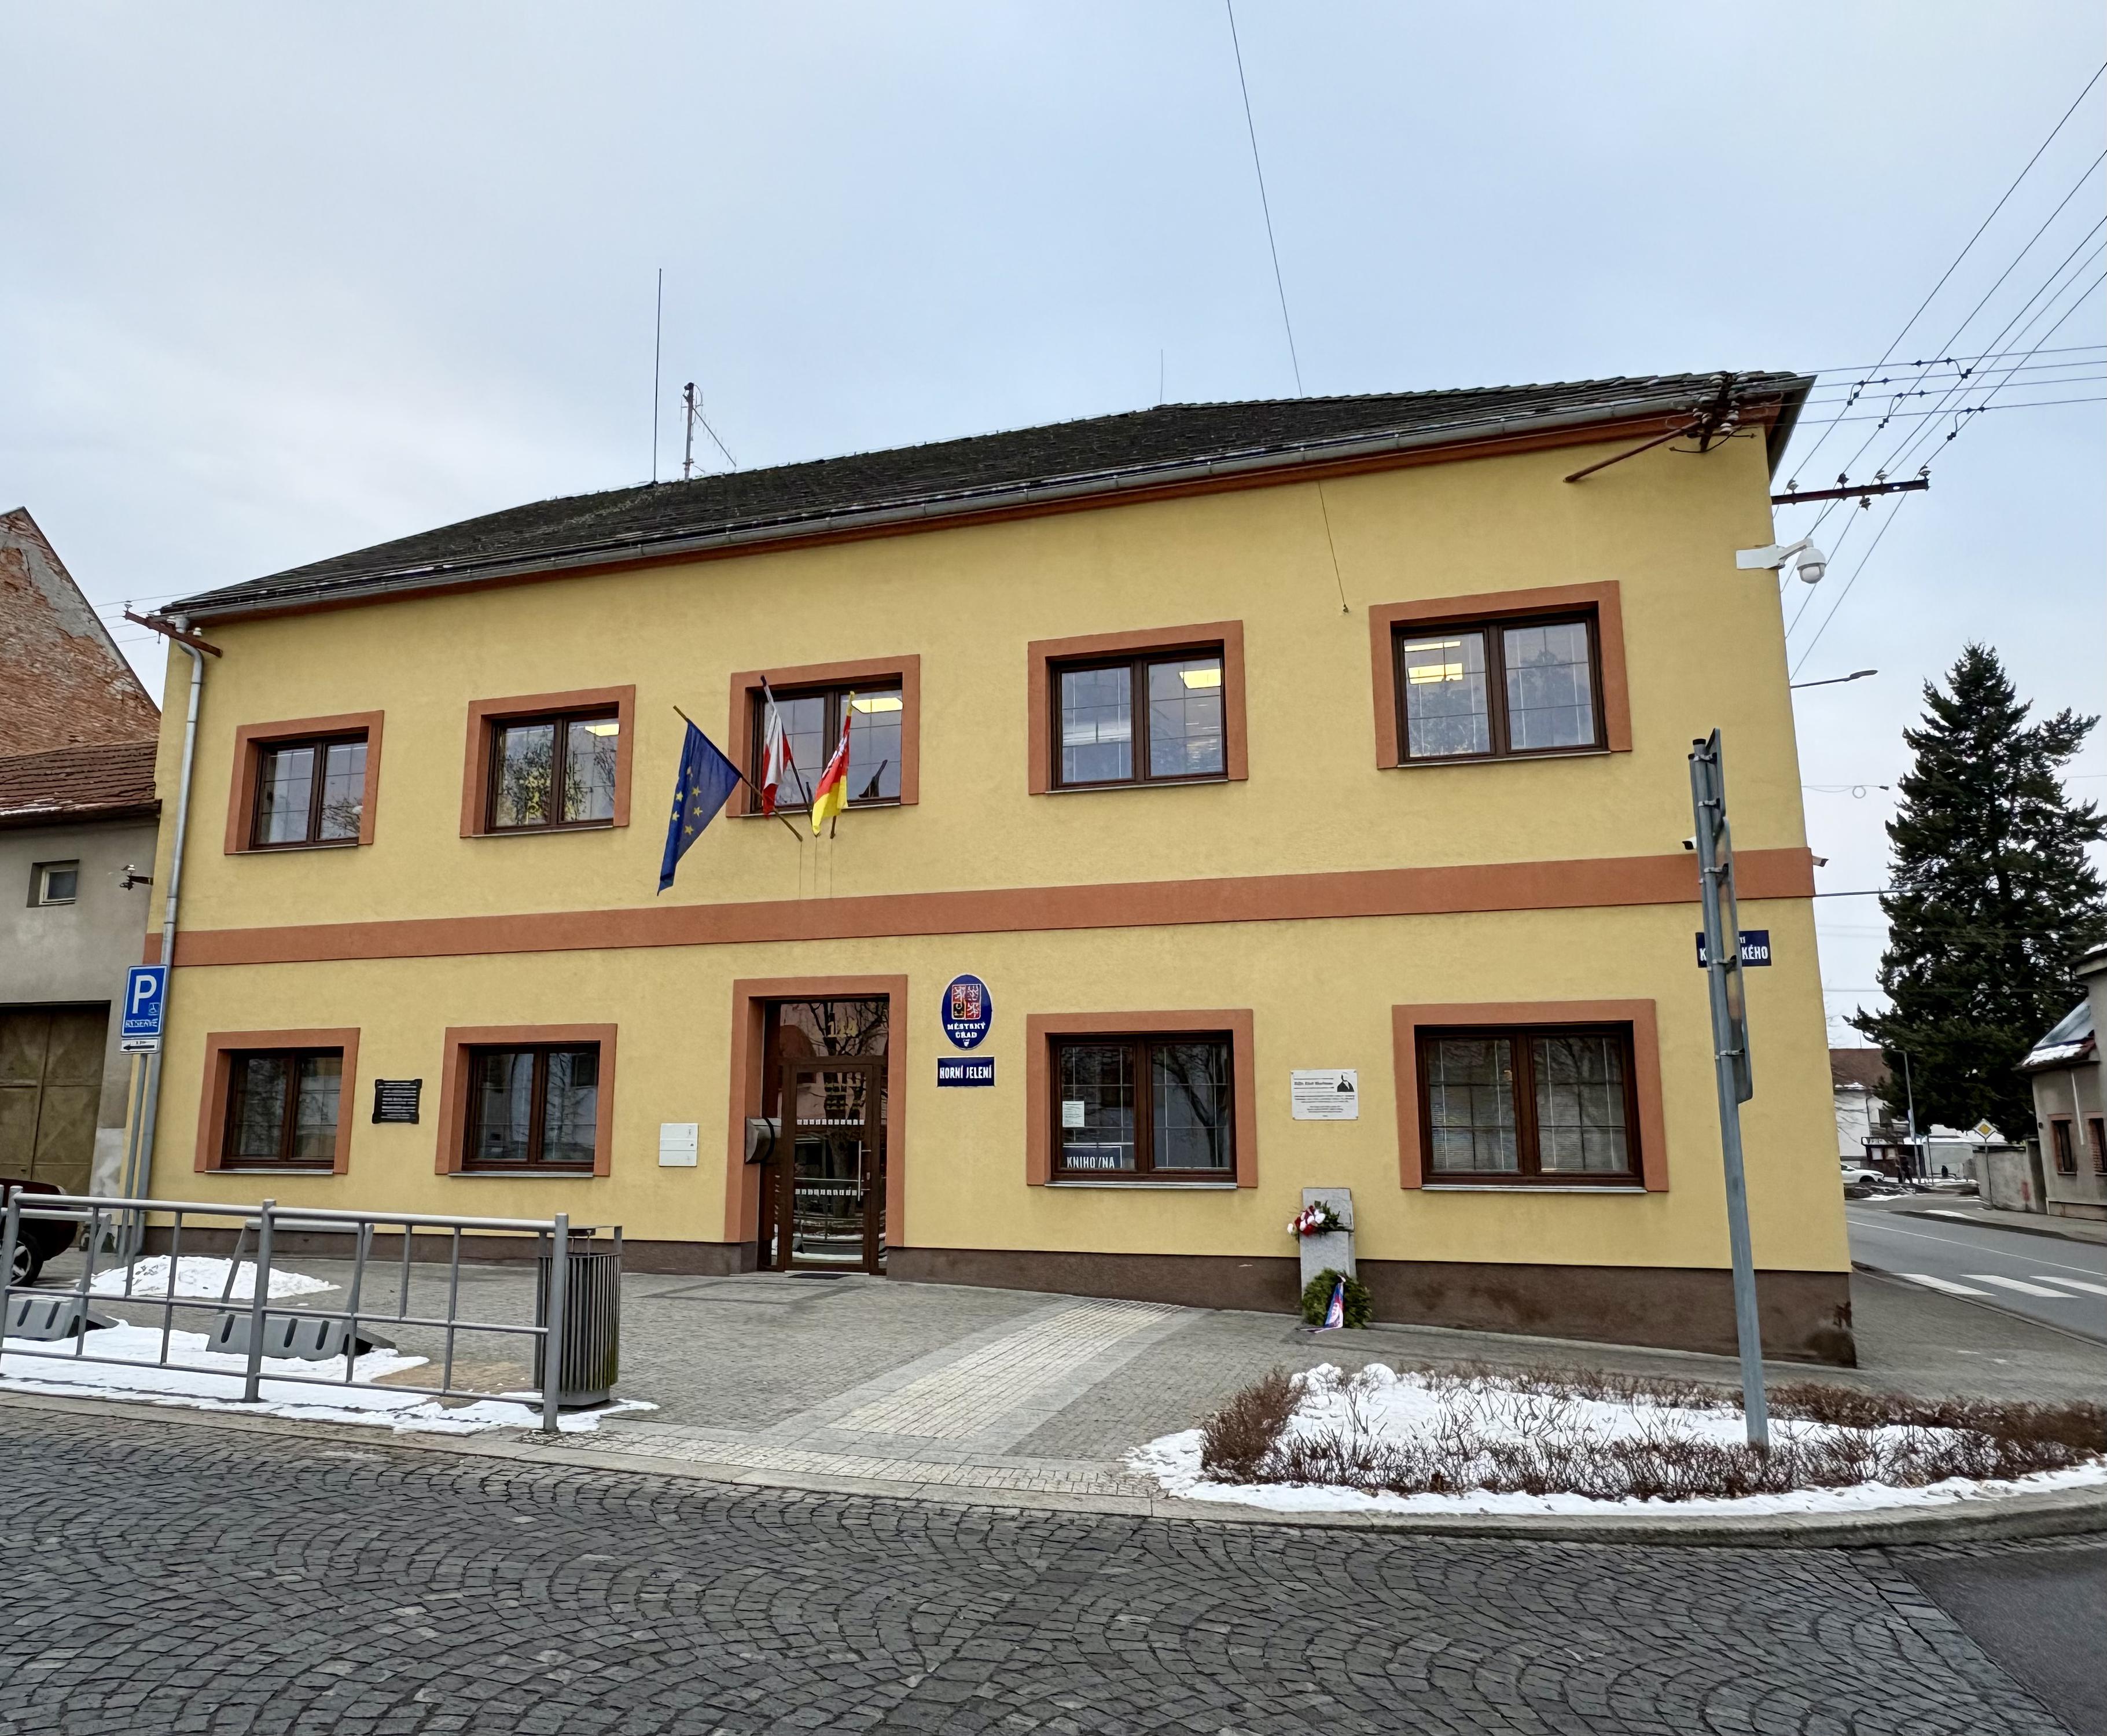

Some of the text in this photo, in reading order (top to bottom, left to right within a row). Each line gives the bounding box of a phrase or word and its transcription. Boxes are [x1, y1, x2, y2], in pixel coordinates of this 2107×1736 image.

[132, 974, 157, 1014] P
[940, 1065, 992, 1079] HORNÍ JELENÍ
